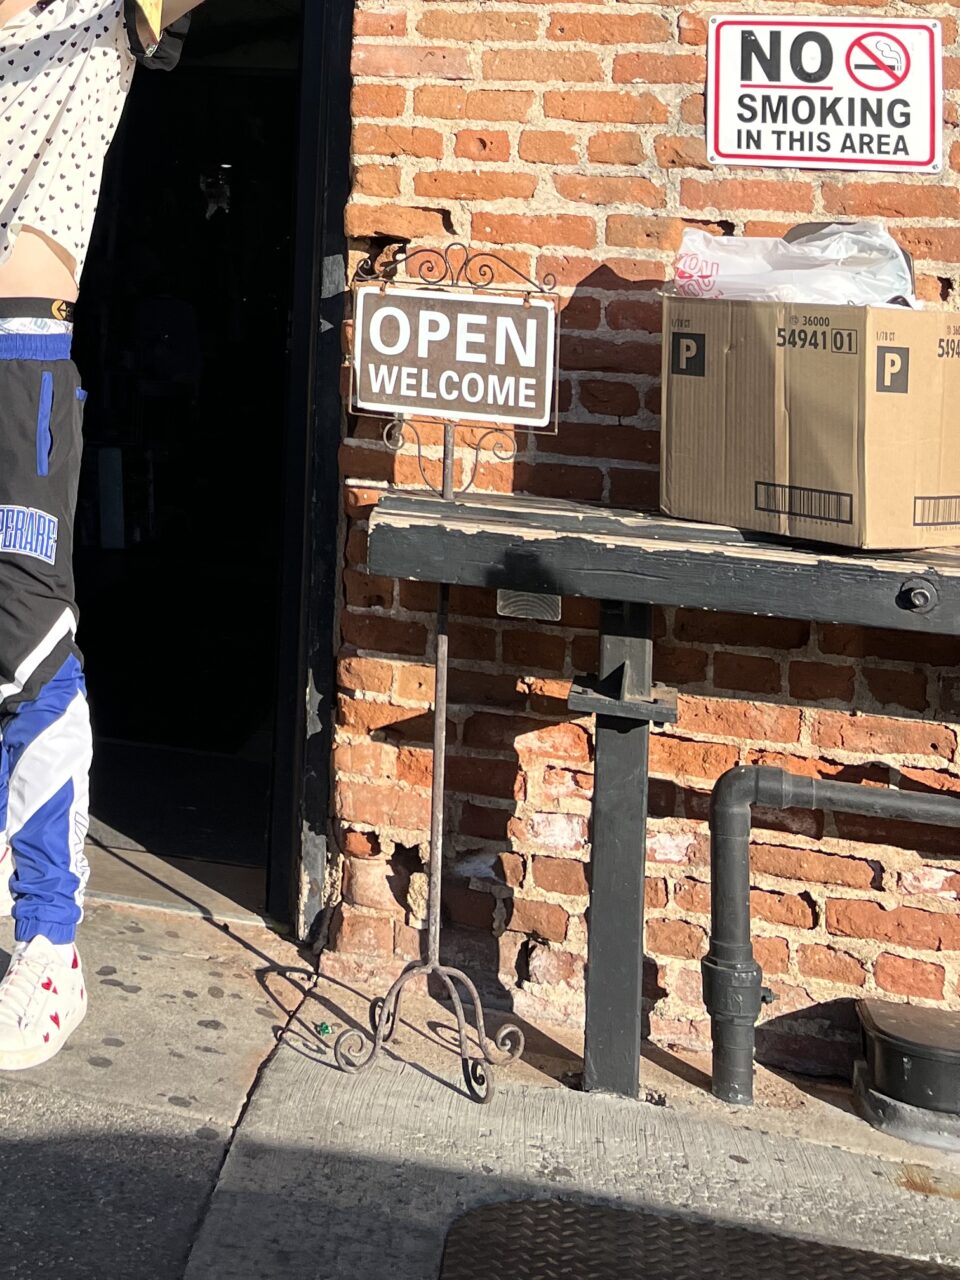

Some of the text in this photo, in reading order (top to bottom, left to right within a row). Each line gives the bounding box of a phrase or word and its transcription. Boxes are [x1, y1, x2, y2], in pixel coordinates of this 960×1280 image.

[740, 30, 834, 83] NO
[737, 93, 912, 129] SMOKING
[737, 128, 910, 156] IN THIS AREA
[369, 306, 538, 368] OPEN
[802, 315, 830, 327] 36000
[679, 338, 697, 370] P
[776, 327, 853, 352] 54941 01
[368, 363, 537, 409] WELCOME
[884, 352, 902, 387] P
